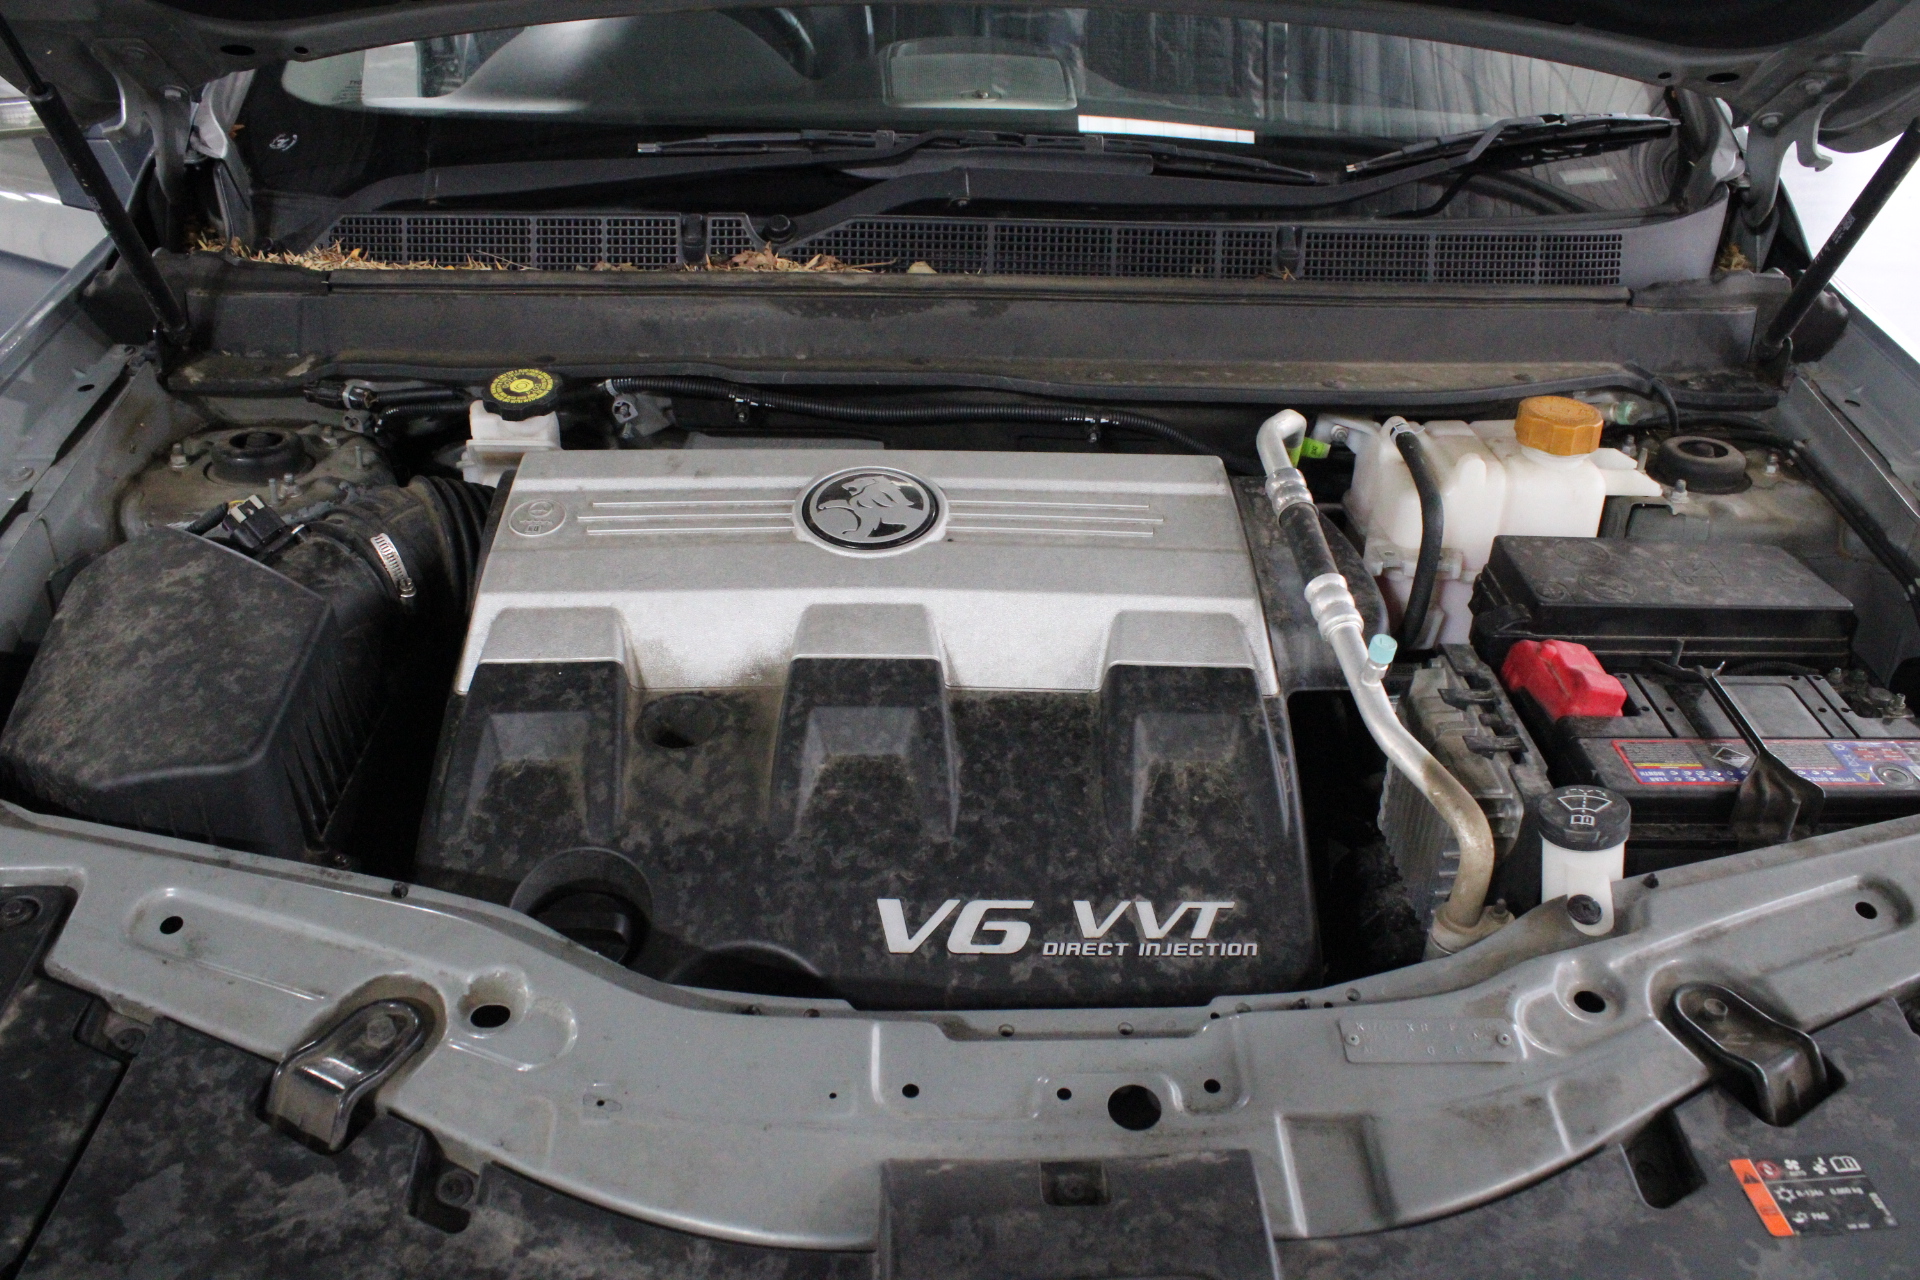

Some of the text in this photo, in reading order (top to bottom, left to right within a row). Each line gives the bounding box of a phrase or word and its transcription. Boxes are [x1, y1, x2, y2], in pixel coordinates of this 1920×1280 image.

[876, 898, 1236, 955] V6 VVT
[1041, 942, 1259, 957] DIRECT INJECTION
